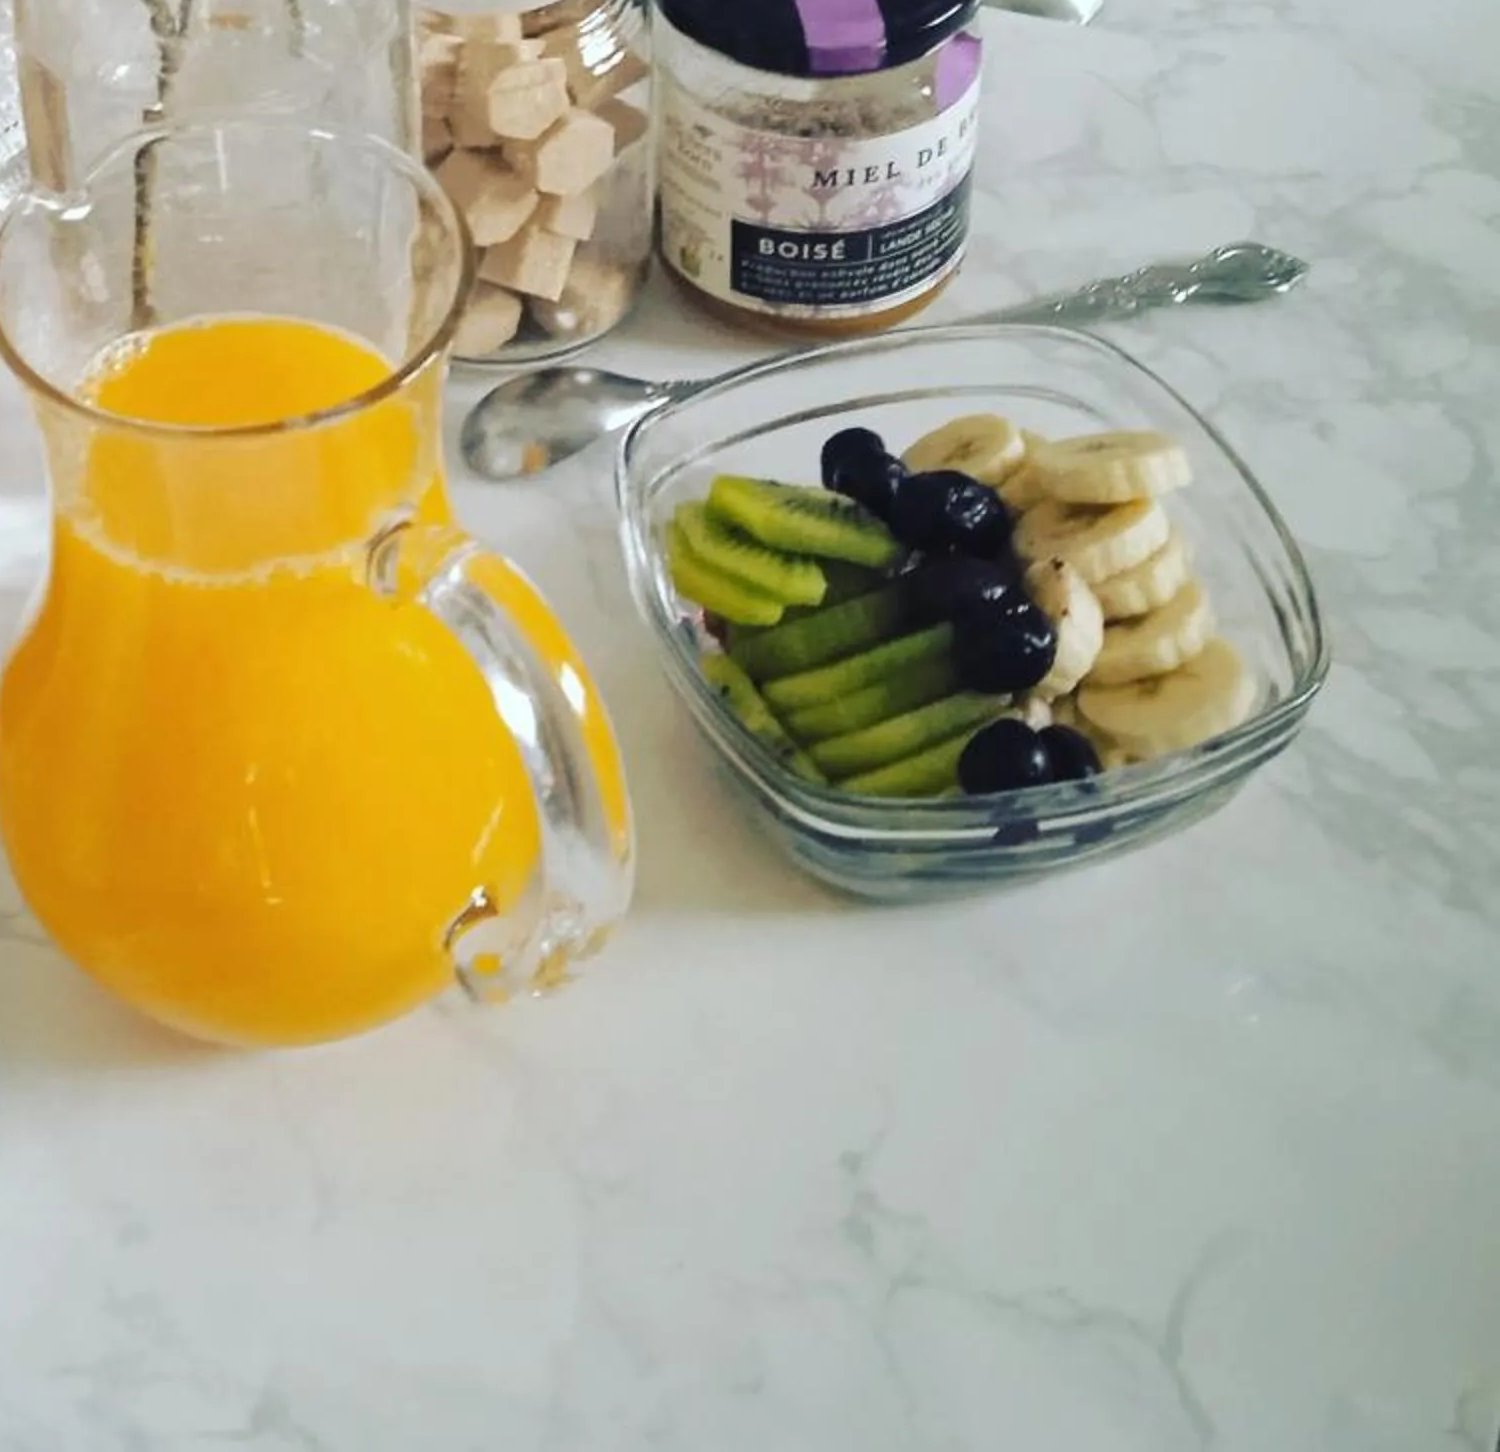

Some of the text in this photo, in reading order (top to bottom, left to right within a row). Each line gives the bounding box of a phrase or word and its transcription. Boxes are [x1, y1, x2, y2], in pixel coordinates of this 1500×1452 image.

[812, 160, 901, 189] MIEL
[916, 136, 948, 169] DE
[758, 236, 846, 261] BOISÉ
